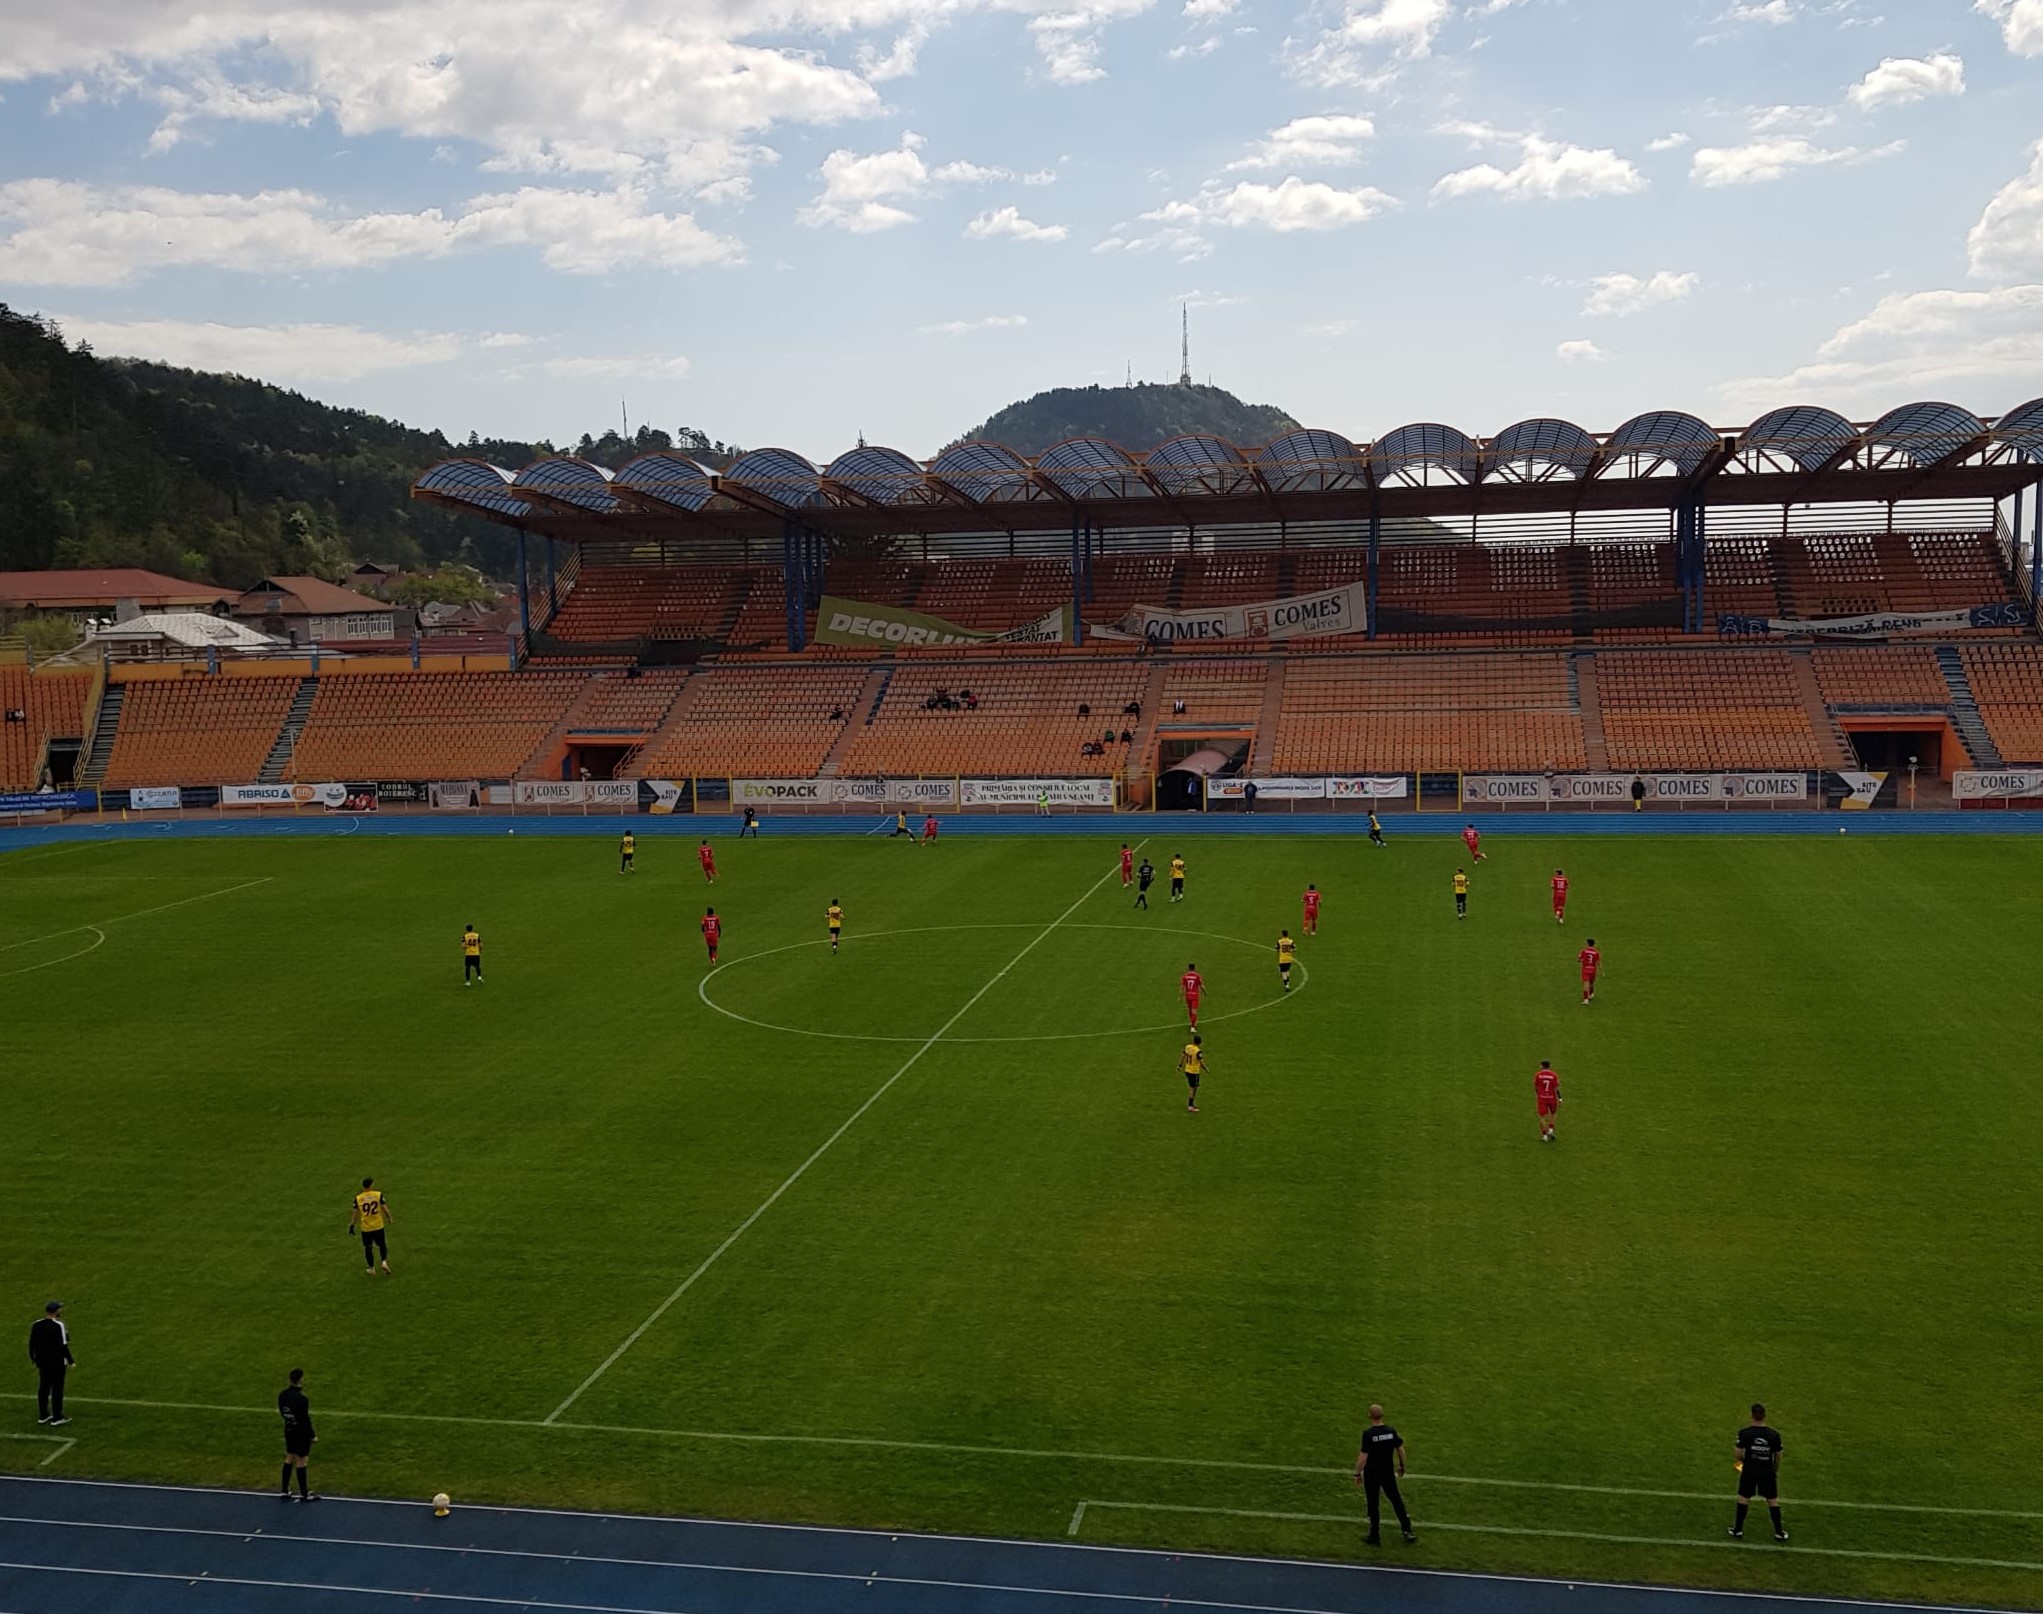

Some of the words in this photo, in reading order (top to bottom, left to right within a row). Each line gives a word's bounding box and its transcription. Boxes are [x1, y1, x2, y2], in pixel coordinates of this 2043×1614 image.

[1275, 596, 1341, 626] COMES
[1144, 619, 1224, 640] COMES
[1488, 782, 1538, 796] COMES
[1572, 780, 1623, 795] COMES
[1658, 779, 1709, 795] COMES
[1745, 778, 1798, 794] COMES
[1980, 775, 2025, 789] COMES
[537, 785, 570, 796] COMES
[597, 784, 631, 796] COMES
[851, 784, 886, 795] COMES
[914, 784, 950, 795] COMES
[1543, 1079, 1551, 1092] 7
[361, 1201, 379, 1217] 92
